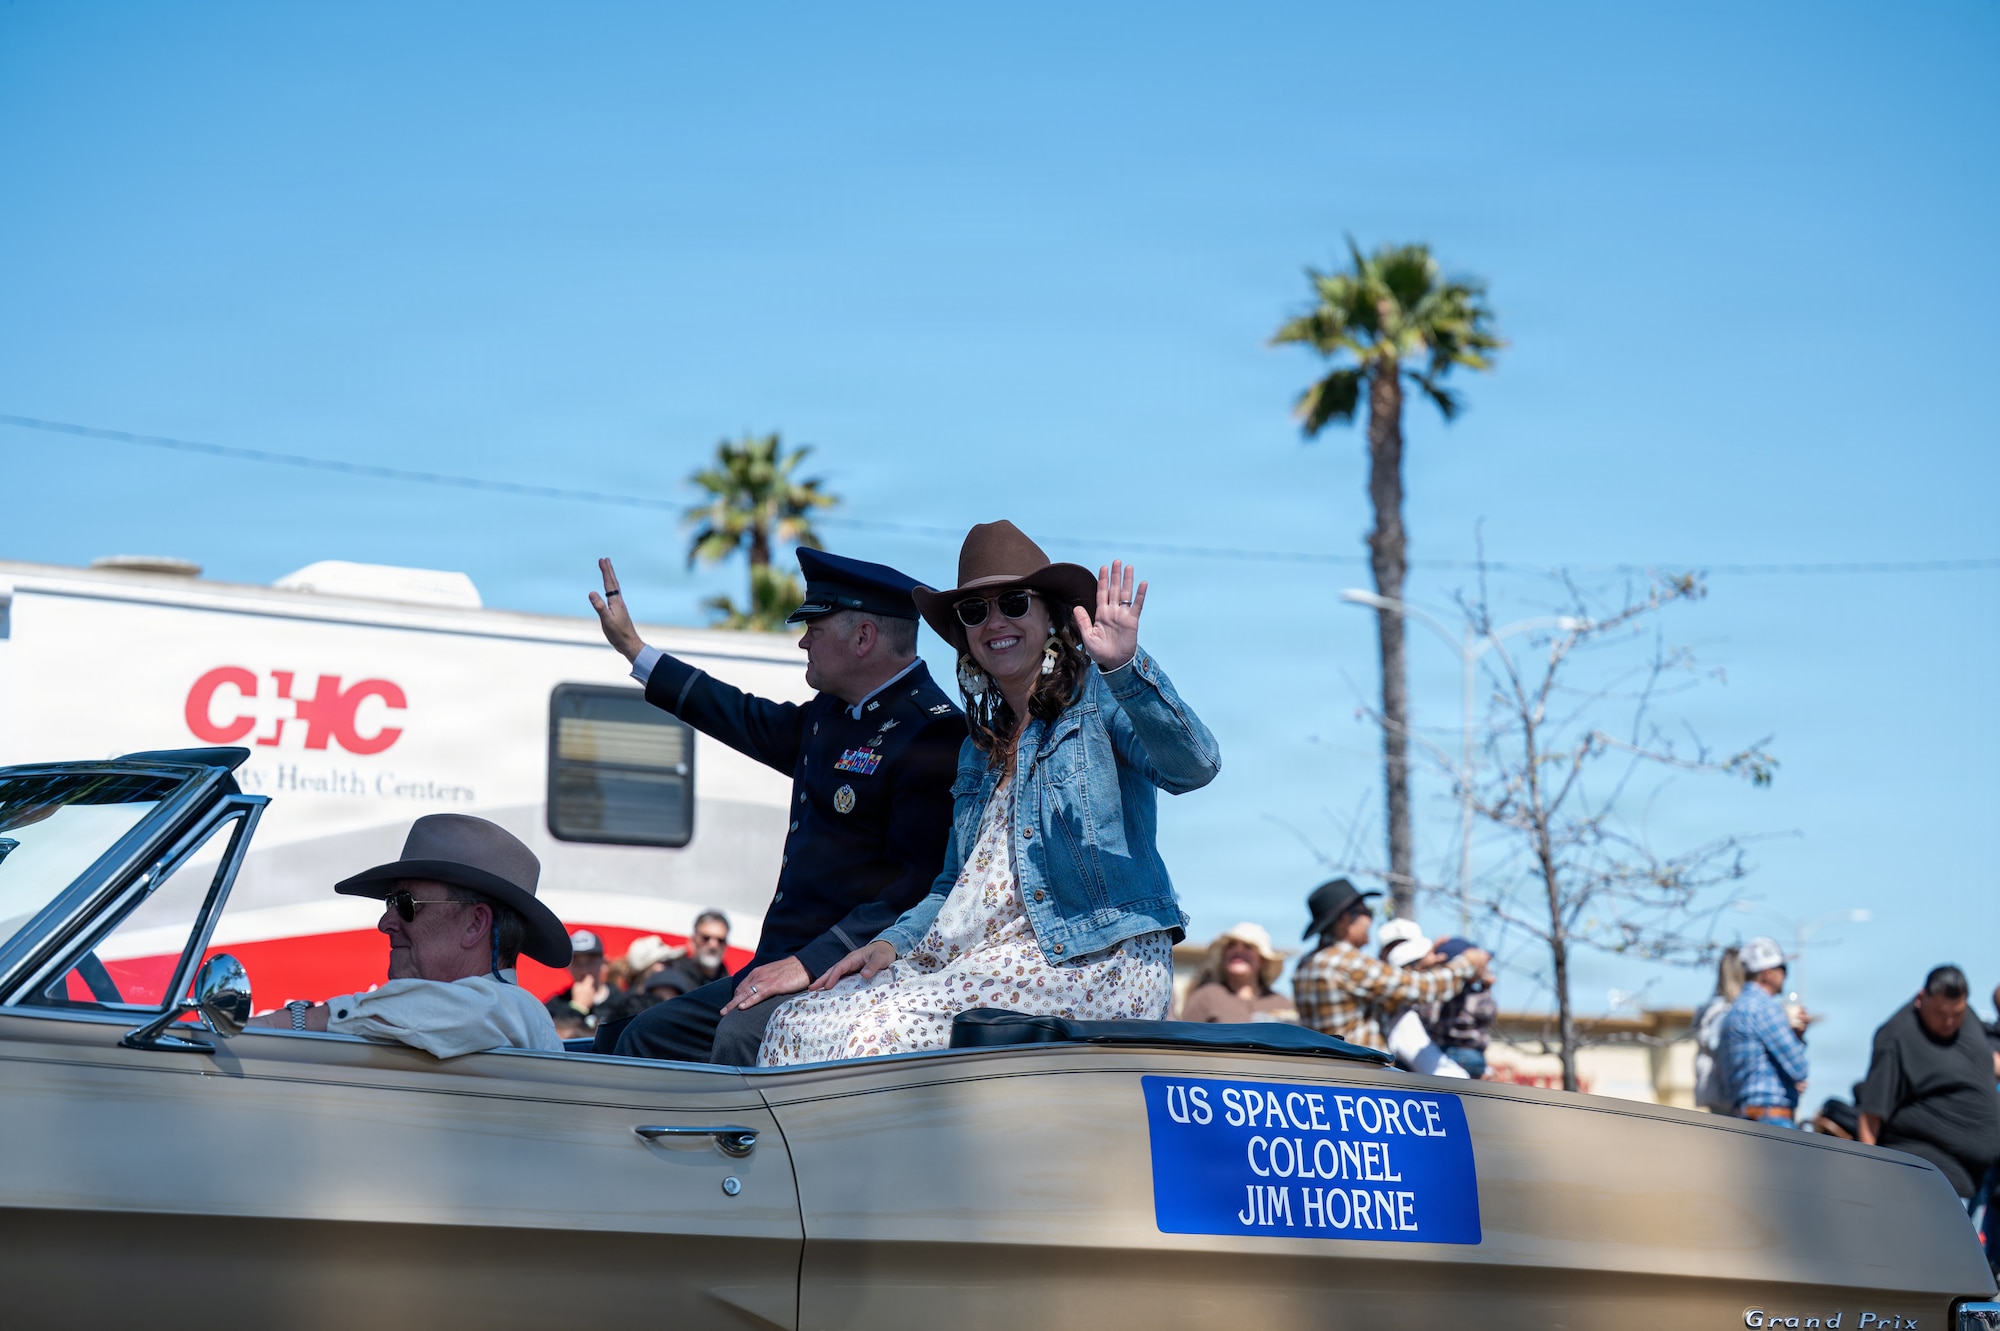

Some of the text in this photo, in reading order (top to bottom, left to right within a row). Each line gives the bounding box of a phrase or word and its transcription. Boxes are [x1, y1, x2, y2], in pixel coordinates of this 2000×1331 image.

[185, 666, 407, 754] CHC
[277, 764, 367, 795] Health
[376, 771, 476, 801] Centers
[1166, 1085, 1447, 1137] US SPACE FORCE
[1247, 1136, 1402, 1182] COLONEL
[1238, 1185, 1419, 1232] JIM HORNE
[1744, 1310, 1918, 1331] Grand Prix
